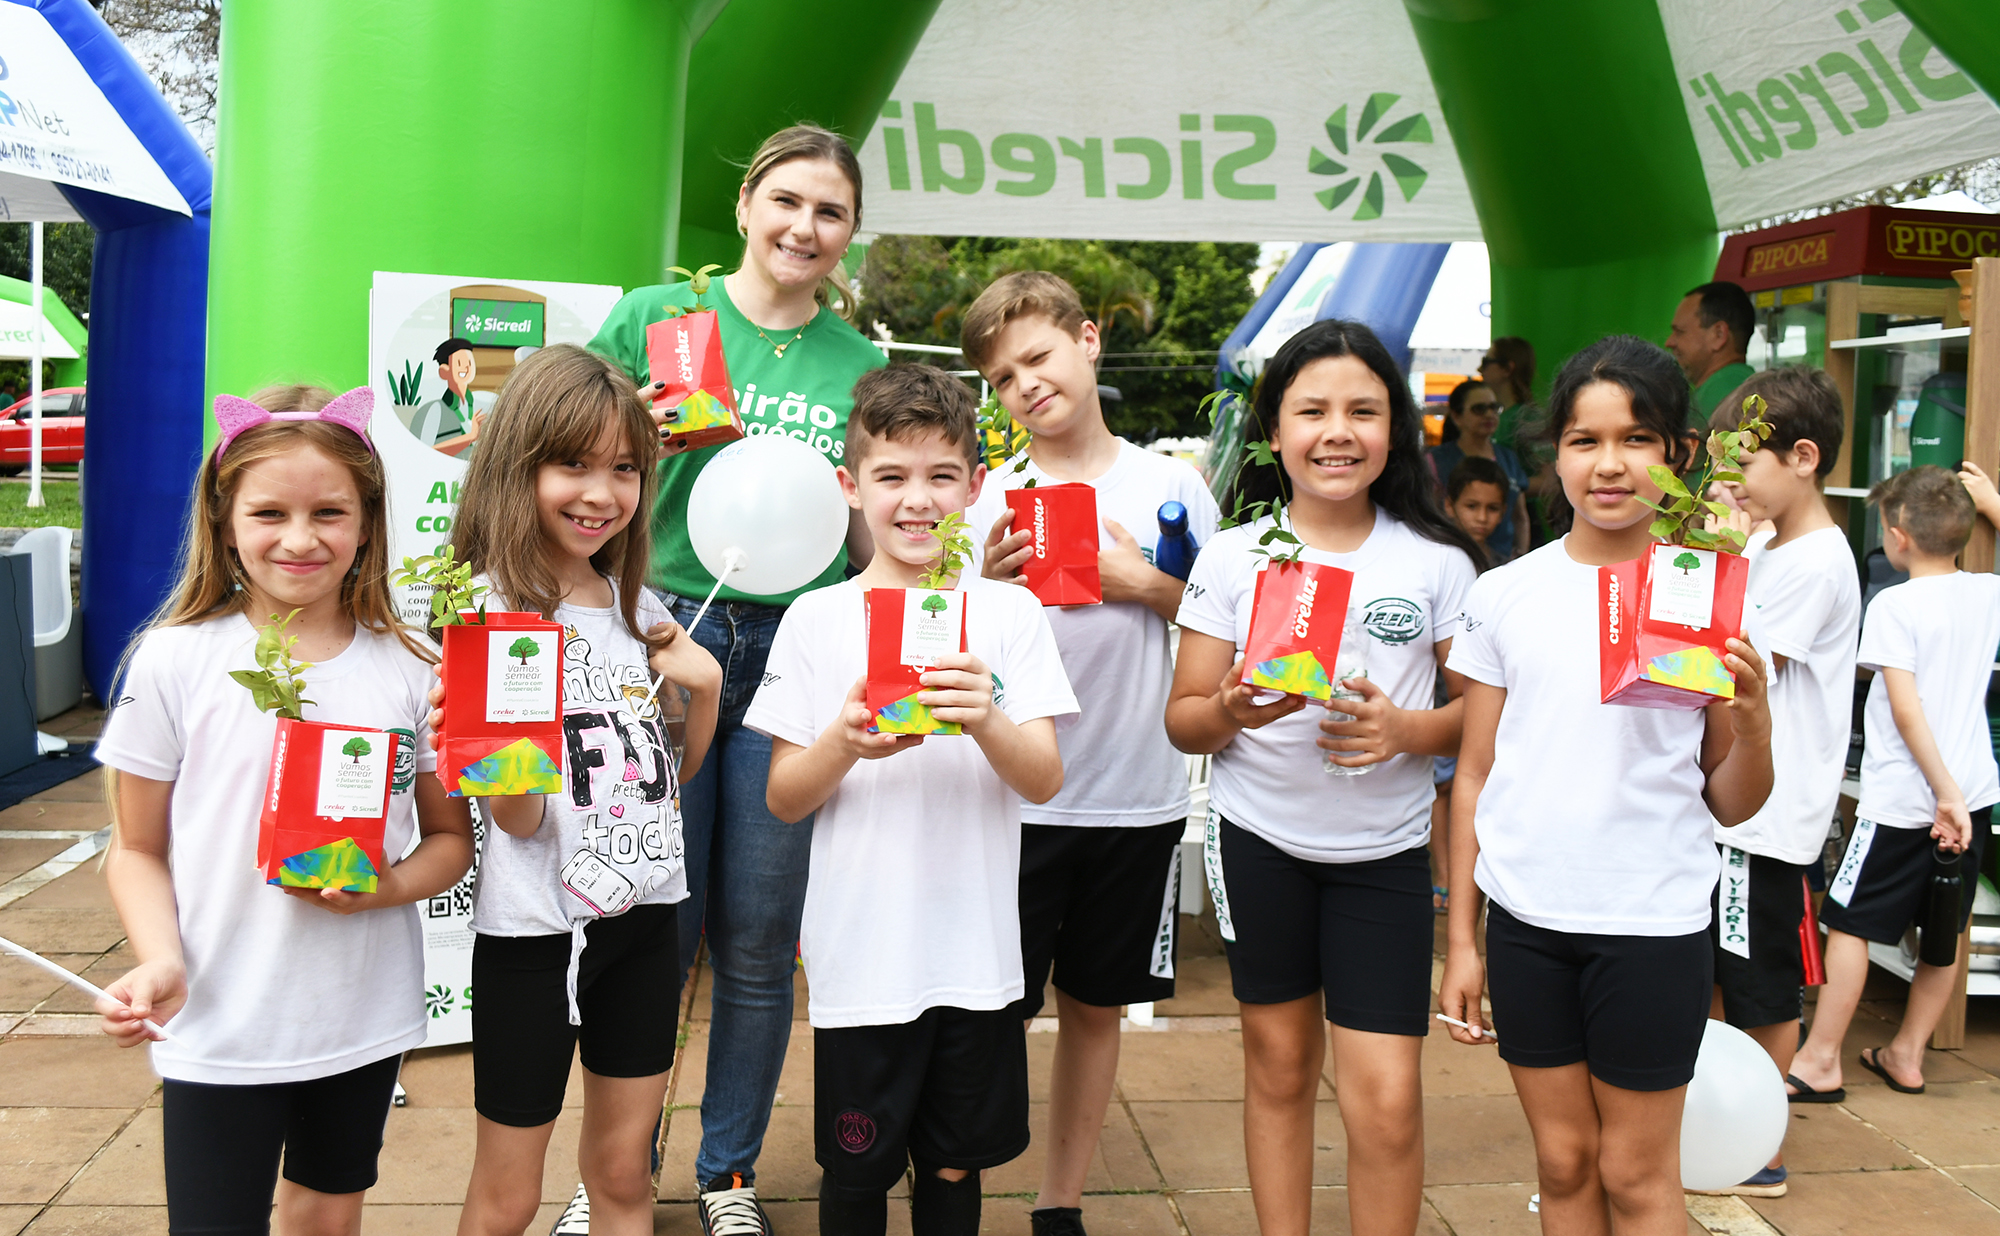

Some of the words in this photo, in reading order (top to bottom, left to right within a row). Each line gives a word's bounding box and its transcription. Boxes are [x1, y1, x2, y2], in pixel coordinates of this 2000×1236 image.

[17, 99, 70, 136] Net
[1892, 225, 2000, 258] PIPOC
[1750, 238, 1829, 273] PIPOCA
[484, 317, 532, 333] Sicredi
[674, 329, 694, 382] creluz
[415, 515, 452, 533] co
[1295, 576, 1318, 639] creluz
[1362, 611, 1426, 629] IEEPV
[505, 672, 542, 680] semear
[507, 664, 540, 673] Vamos
[562, 652, 647, 704] make
[337, 770, 372, 778] semear
[340, 762, 371, 771] Vamos
[611, 783, 648, 805] pretty
[1839, 835, 1867, 886] VITORIO
[1725, 876, 1746, 944] VITORIO
[842, 1114, 869, 1126] PARIS
